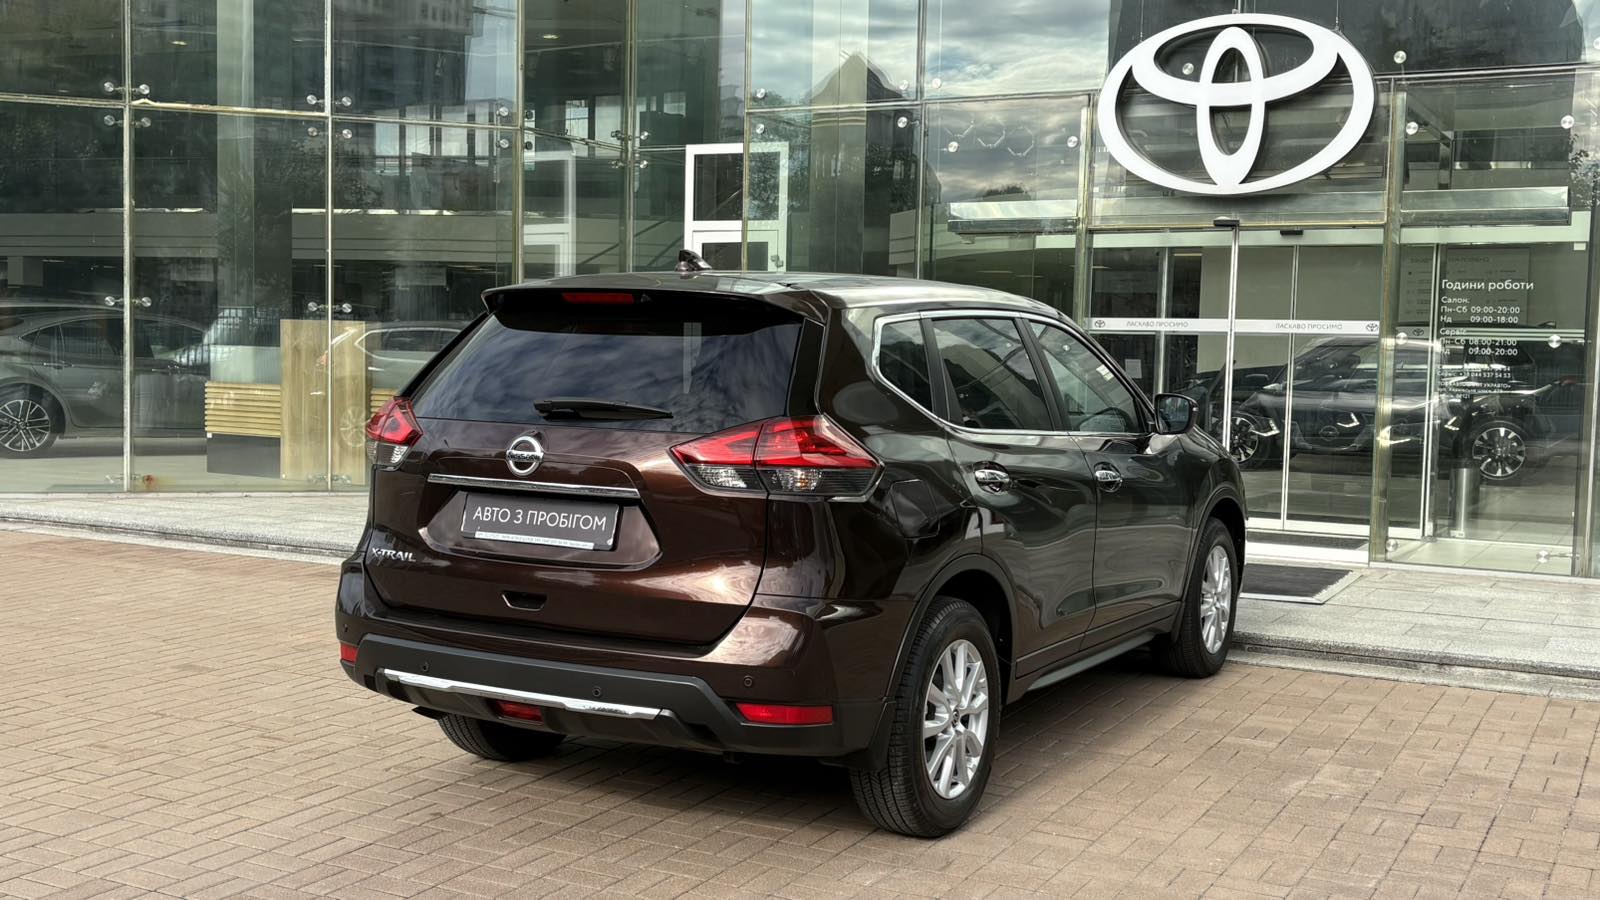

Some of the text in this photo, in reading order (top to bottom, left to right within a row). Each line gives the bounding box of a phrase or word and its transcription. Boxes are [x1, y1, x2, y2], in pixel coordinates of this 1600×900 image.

[1441, 279, 1534, 292] Години роботи
[1440, 305, 1521, 314] Пн-Сб 09:00-20:00
[1440, 315, 1519, 323] Нд 09:00-18:00
[1126, 320, 1189, 328] ЛАСКАВО ПРОСИМО
[1275, 322, 1343, 330] ЛАСКАВО ПРОСИМО
[1468, 347, 1518, 356] 09:00-20:00
[473, 506, 511, 524] АВТО
[526, 510, 607, 531] ПРОБІГОМ
[371, 547, 416, 562] X-TRAIL
